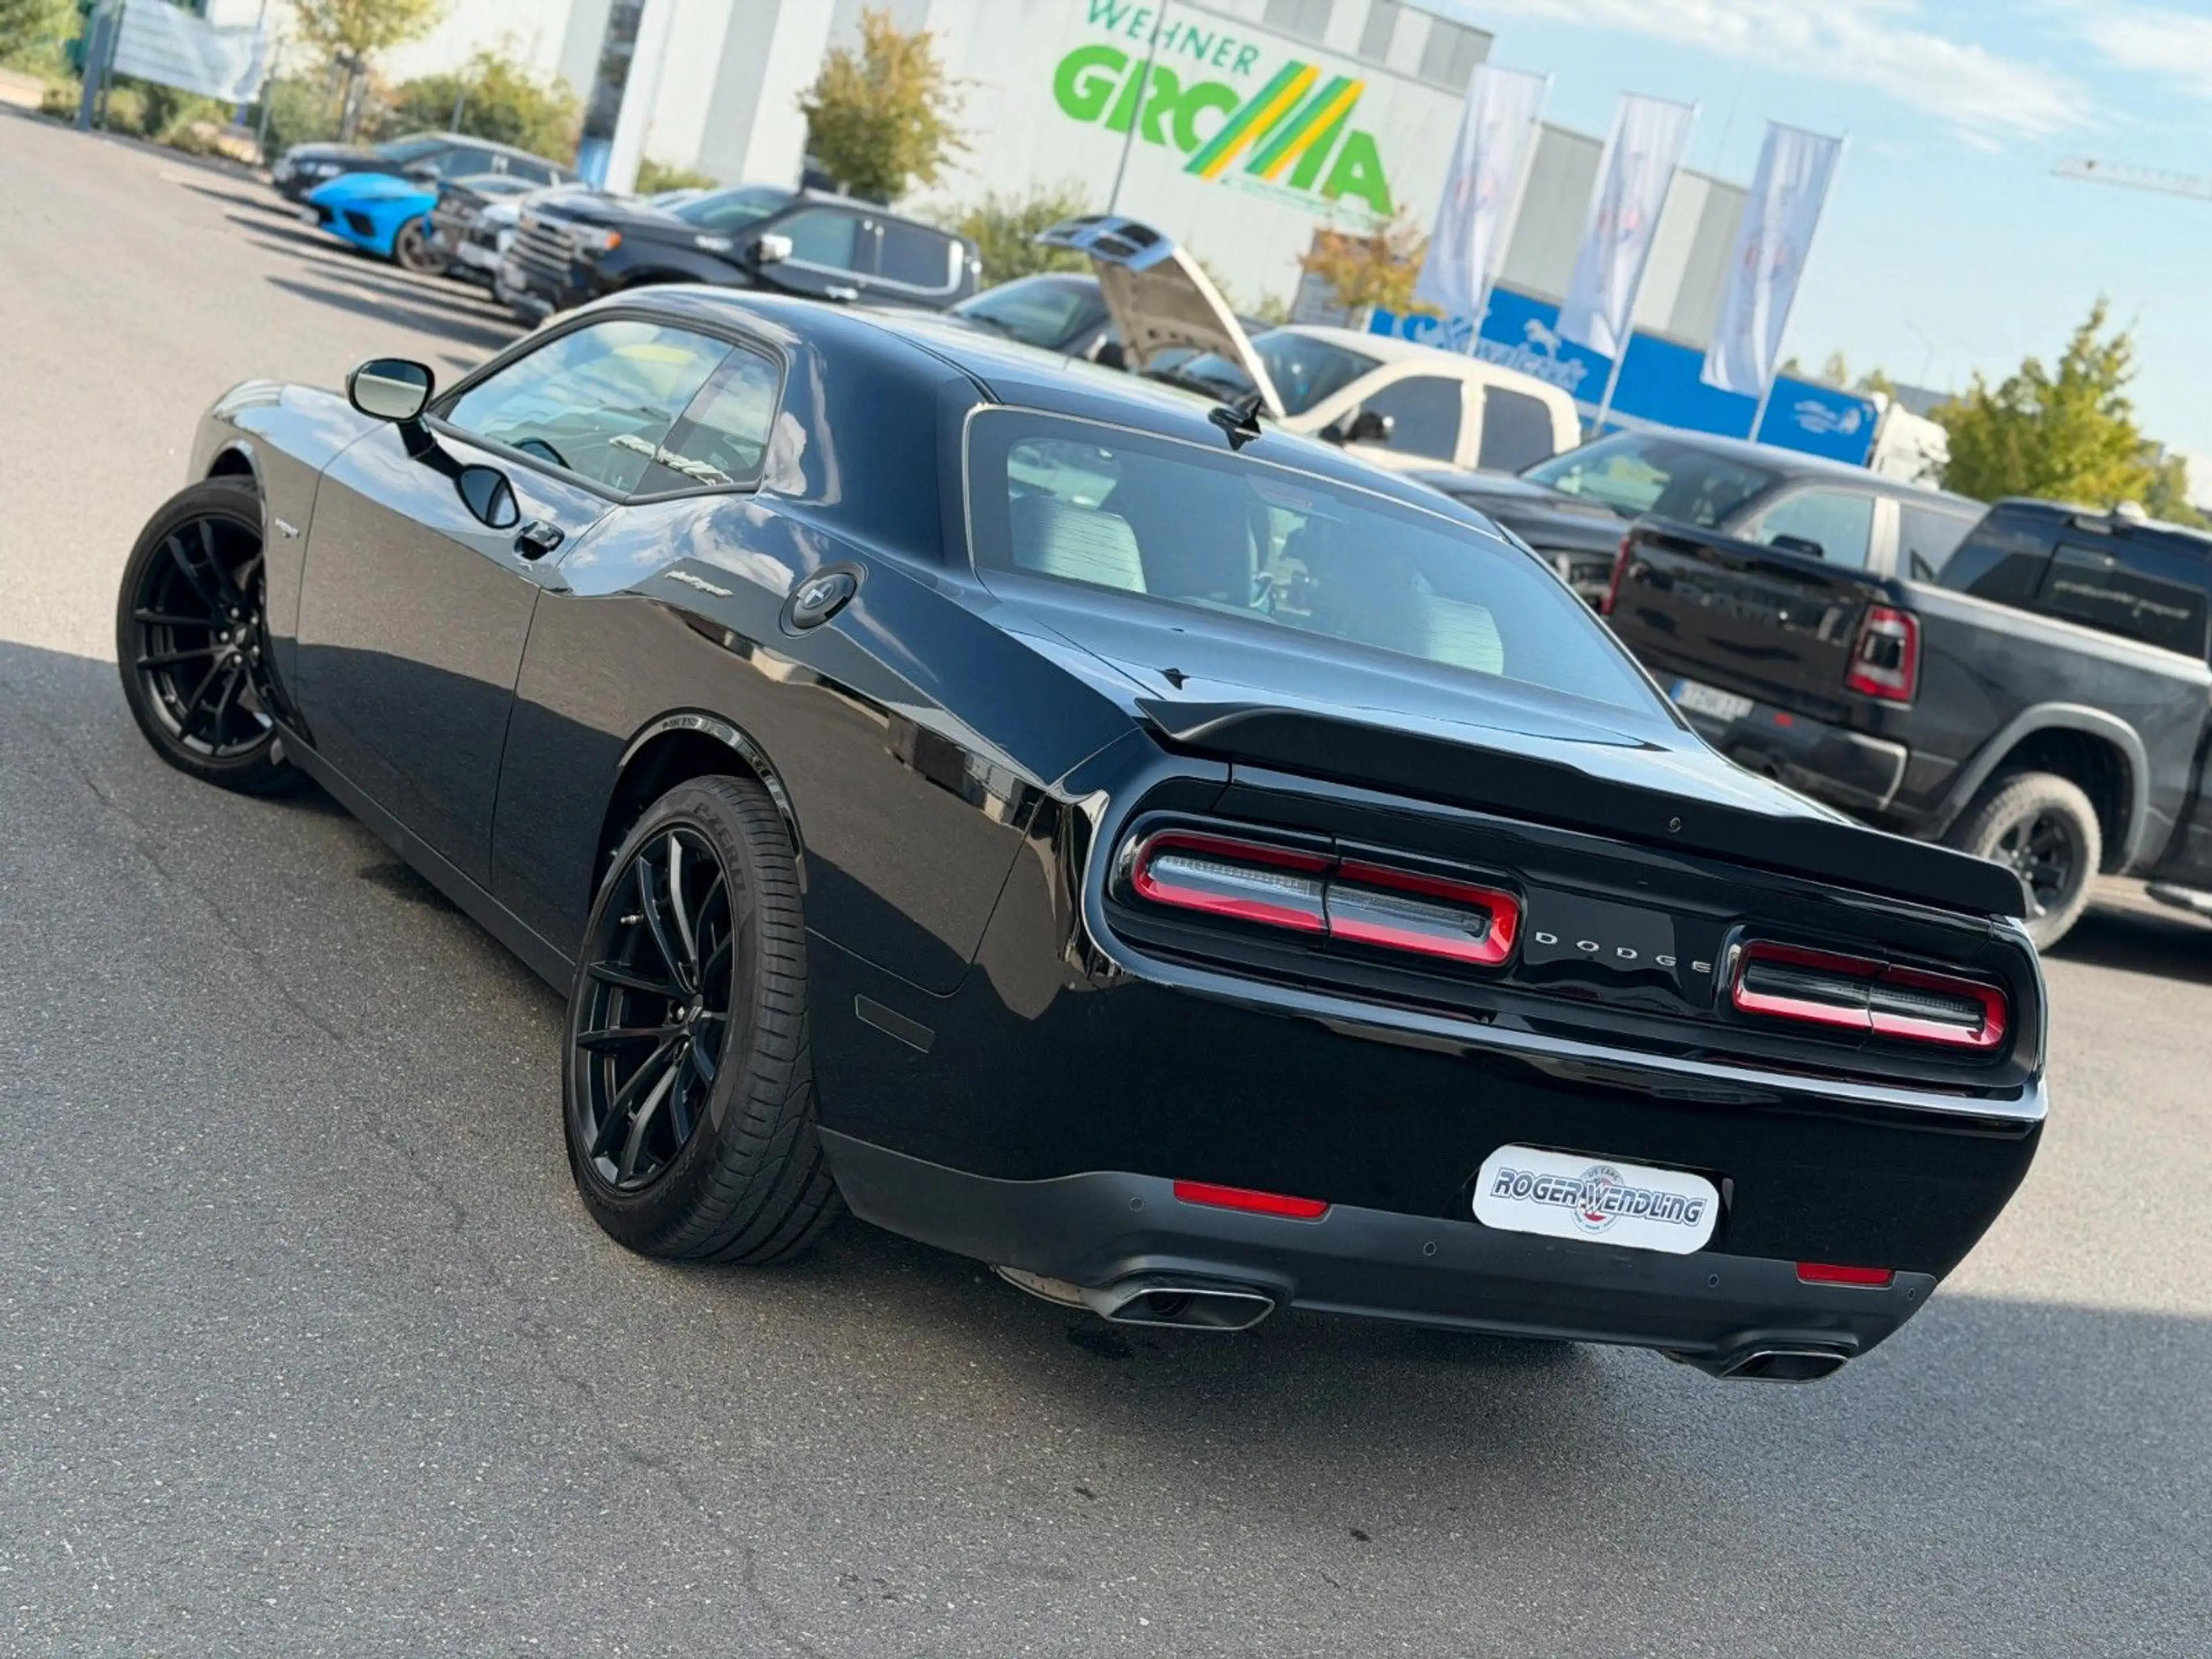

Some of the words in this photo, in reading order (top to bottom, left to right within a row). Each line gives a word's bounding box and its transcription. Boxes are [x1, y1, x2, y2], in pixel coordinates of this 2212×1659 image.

[1087, 0, 1259, 75] WEHNER
[1053, 44, 1395, 217] GROMA
[1535, 931, 1711, 974] DODGE
[1491, 1168, 1582, 1208] ROGER
[1585, 1179, 1707, 1226] WENDLING
